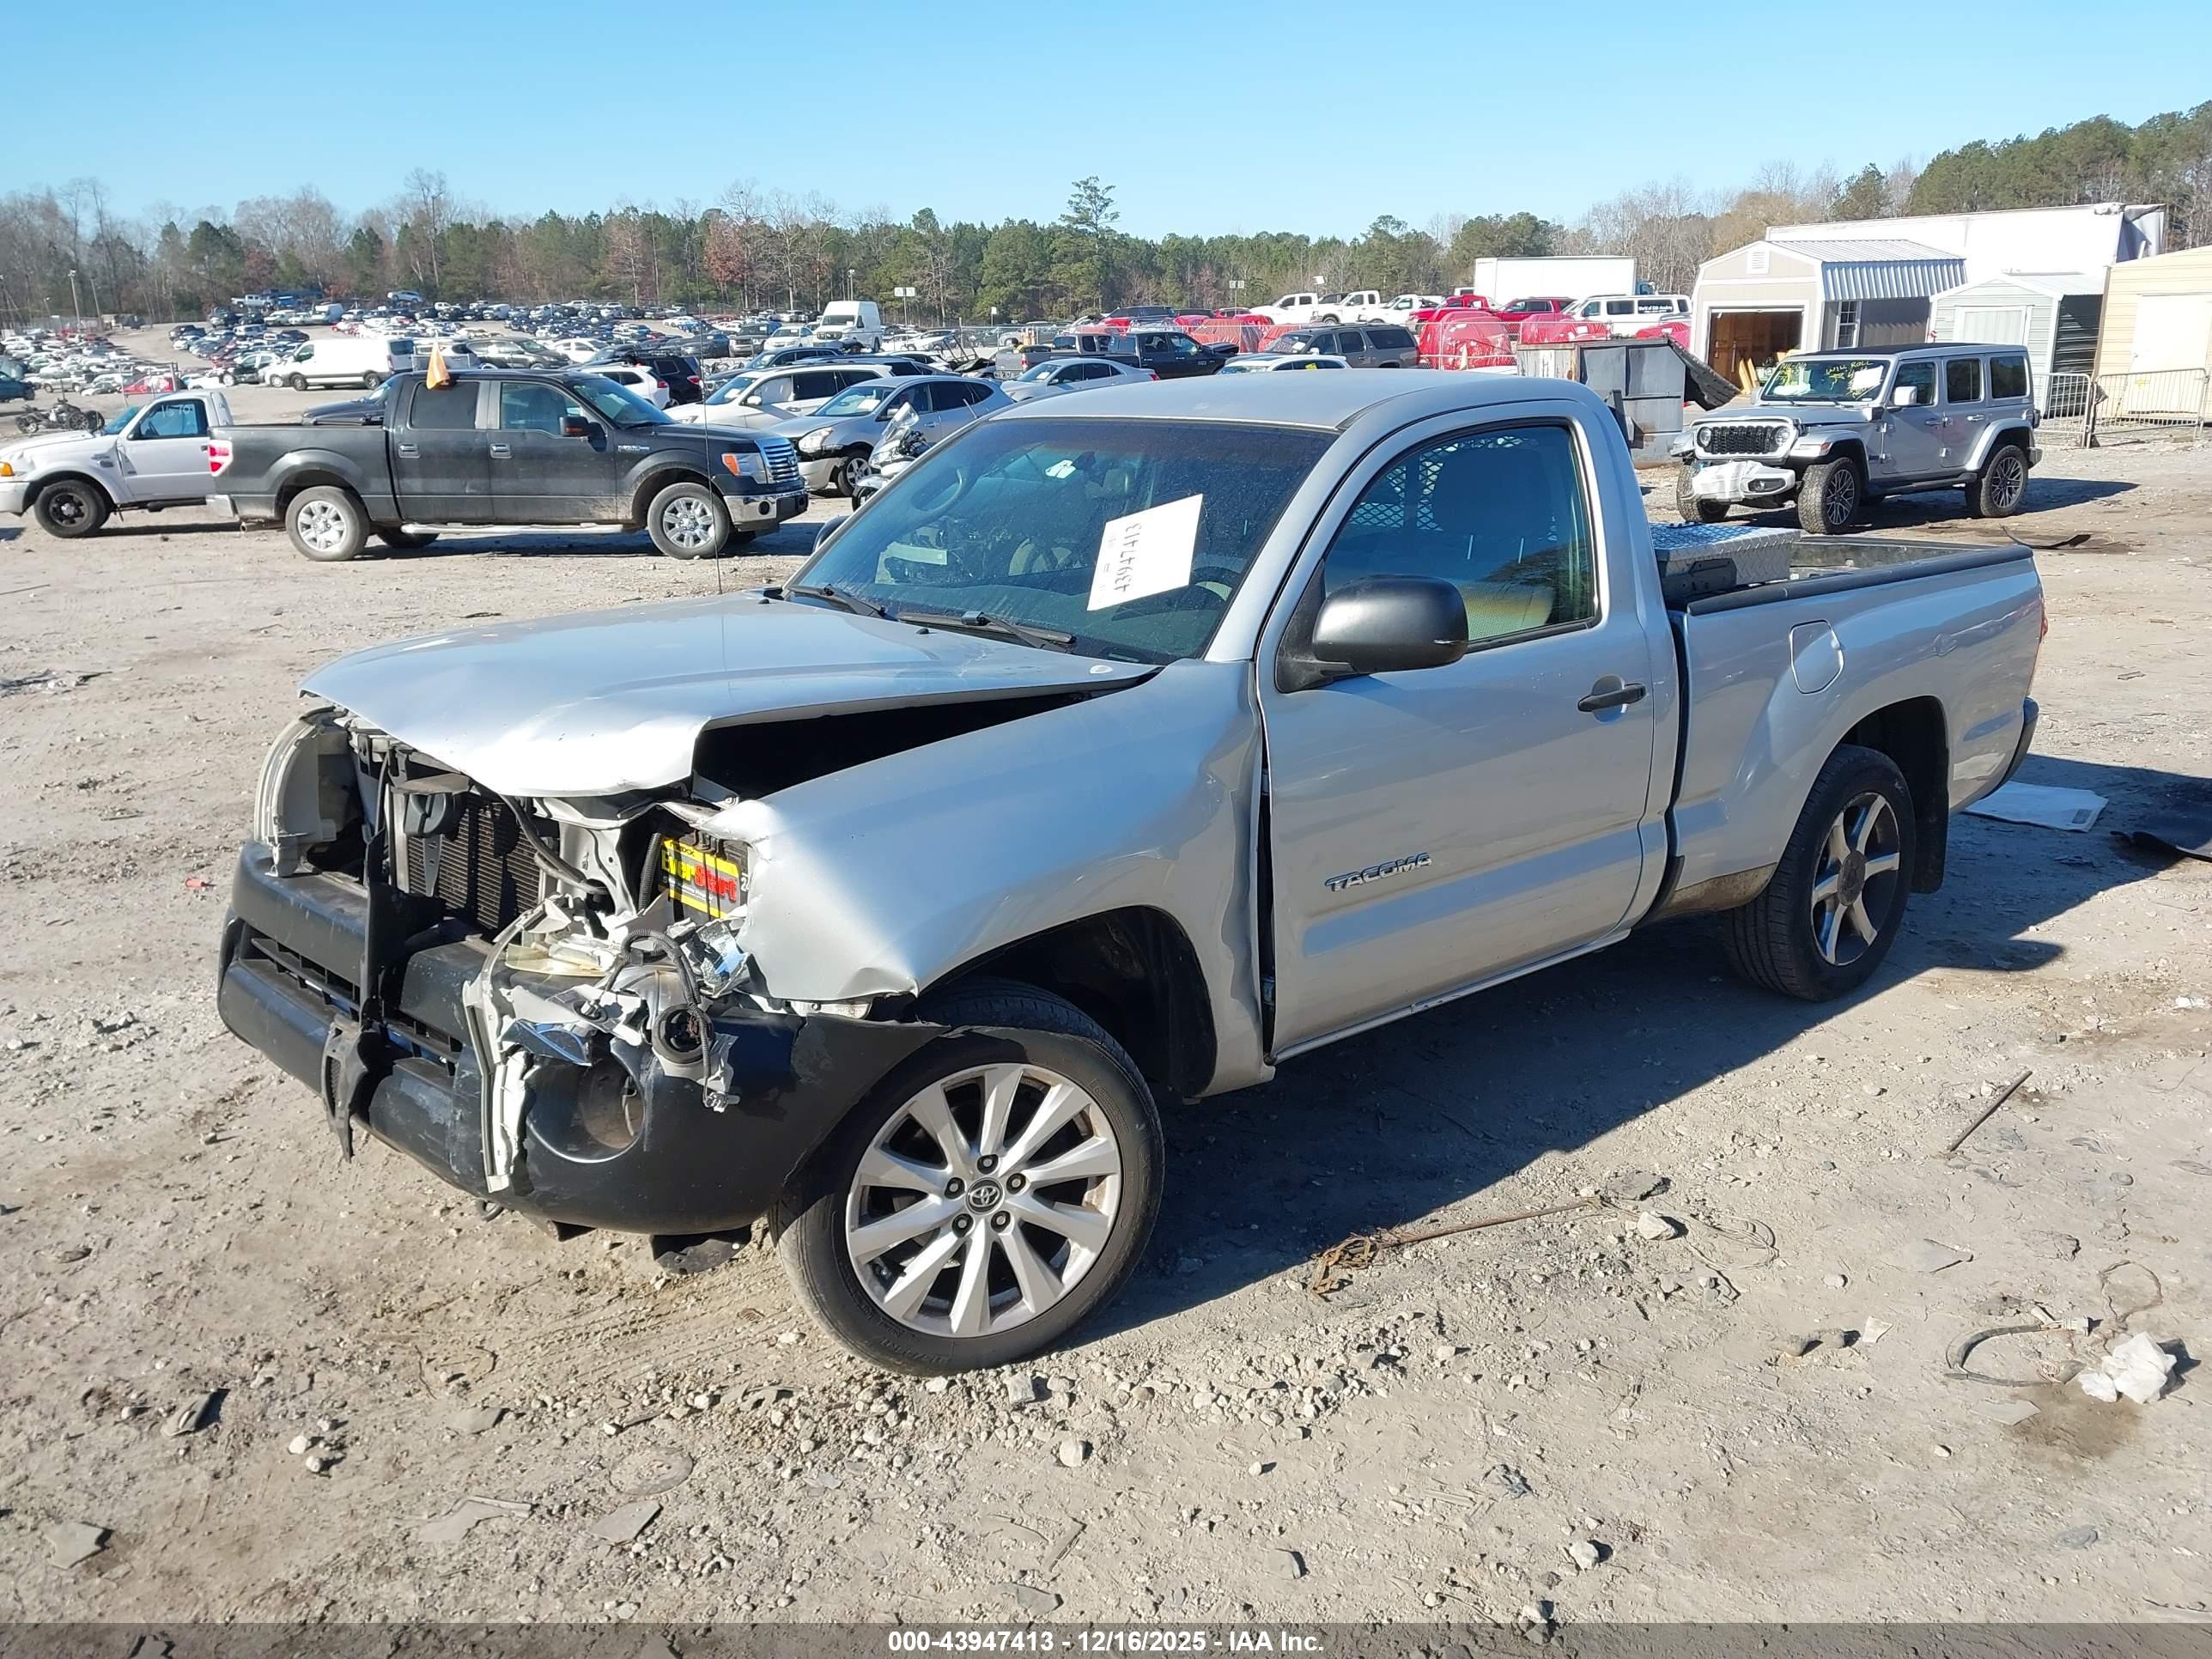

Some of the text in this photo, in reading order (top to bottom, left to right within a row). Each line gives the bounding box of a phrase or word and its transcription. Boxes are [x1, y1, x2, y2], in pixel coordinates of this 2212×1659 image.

[1113, 521, 1142, 592] 43947413
[661, 850, 738, 902] EverStart
[1324, 851, 1432, 892] TACOMA
